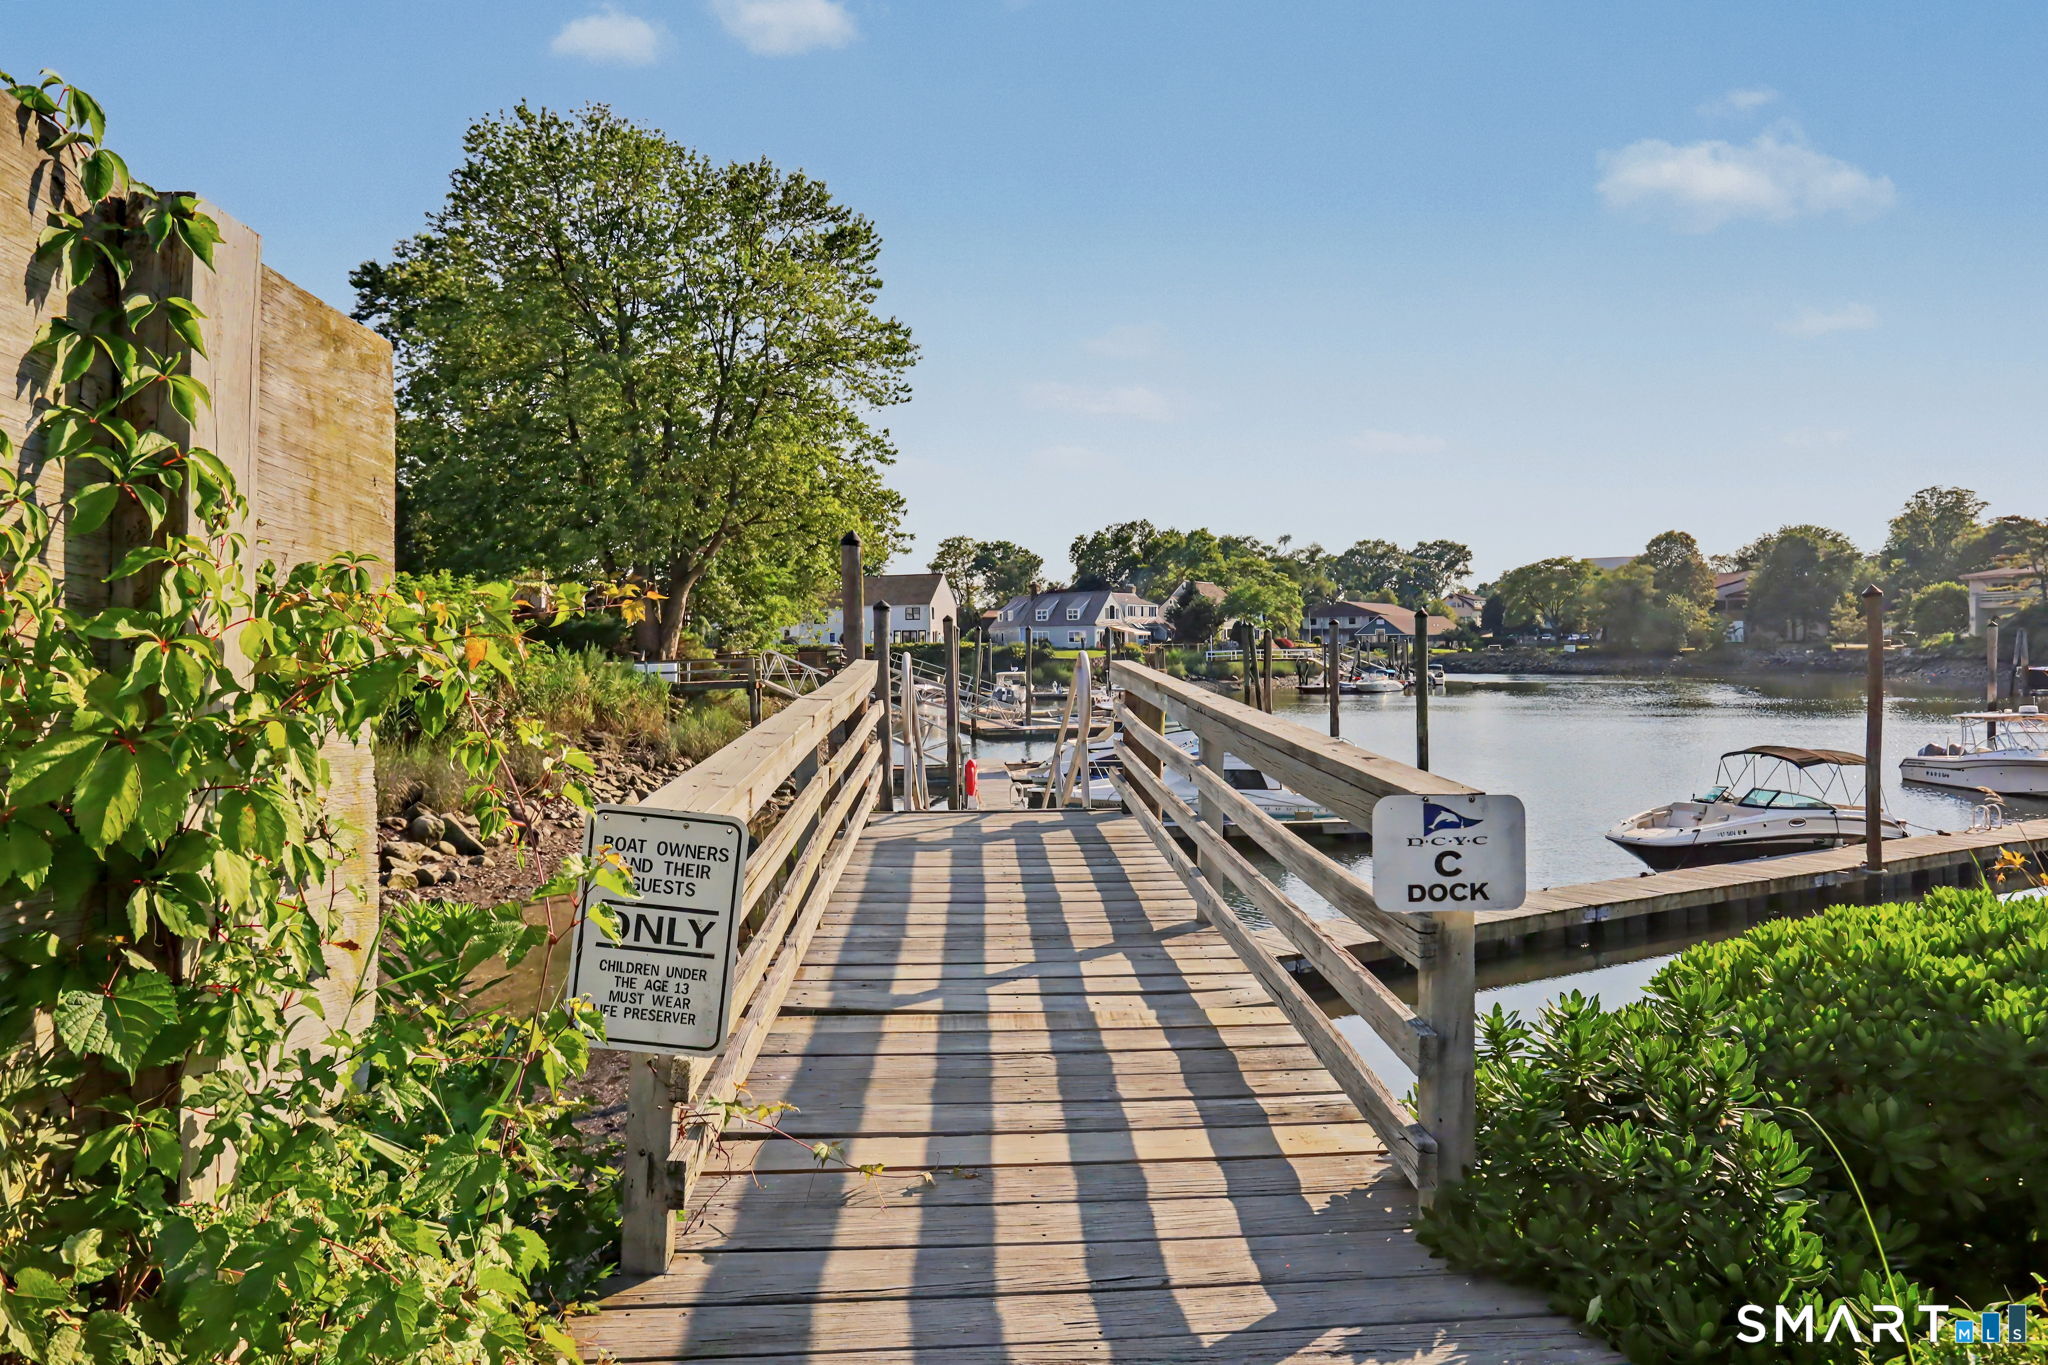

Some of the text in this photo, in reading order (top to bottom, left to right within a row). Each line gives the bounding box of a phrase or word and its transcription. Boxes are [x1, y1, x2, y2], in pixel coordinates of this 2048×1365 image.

[603, 835, 729, 862] BOAT OWNERS
[664, 861, 711, 880] THEIR
[1434, 850, 1462, 877] C
[633, 876, 696, 897] GUESTS
[1407, 882, 1490, 902] DOCK
[600, 910, 716, 949] ONLY
[599, 959, 707, 982] CHILDREN UNDER
[614, 975, 690, 995] THE AGE 13
[608, 990, 691, 1010] MUST WEAR
[623, 1006, 696, 1026] PRESERVER
